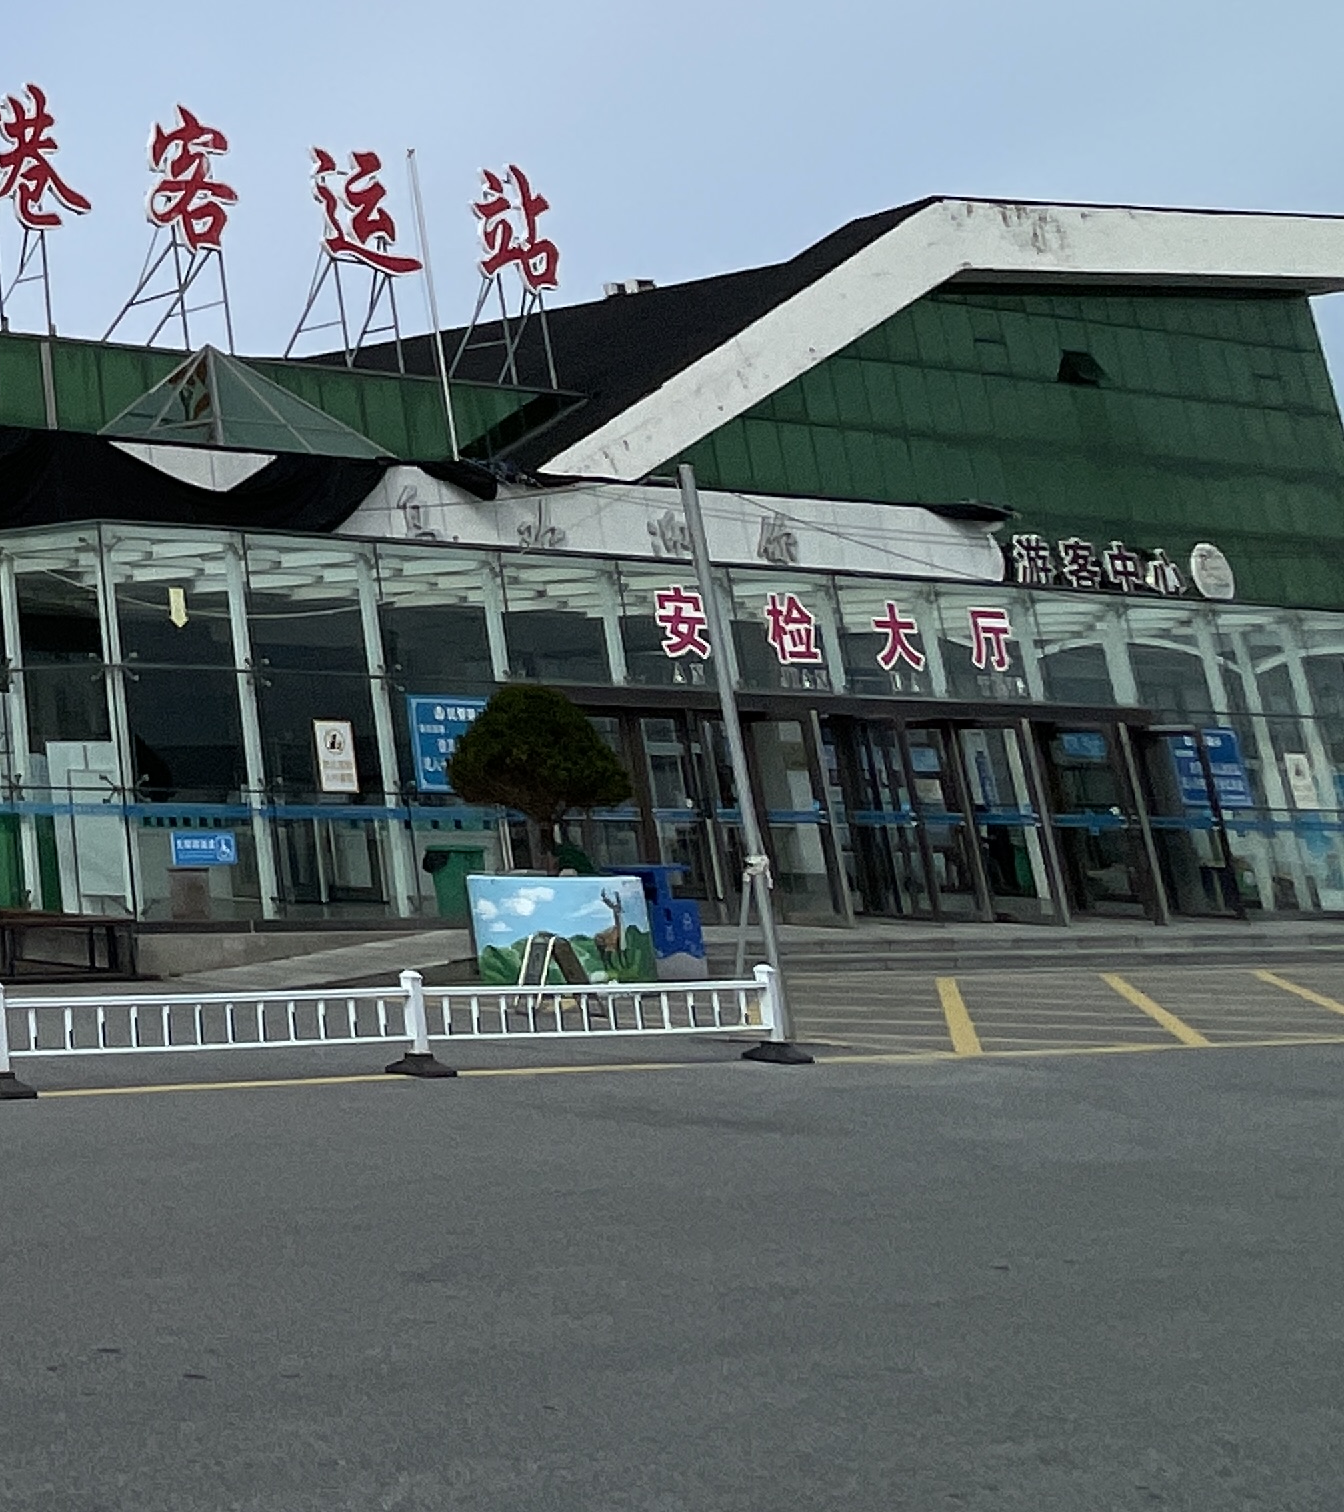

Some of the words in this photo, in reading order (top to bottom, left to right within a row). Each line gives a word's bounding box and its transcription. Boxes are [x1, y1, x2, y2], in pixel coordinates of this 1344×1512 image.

[1011, 534, 1187, 596] 游客中心
[654, 585, 1013, 672] 安检大厅
